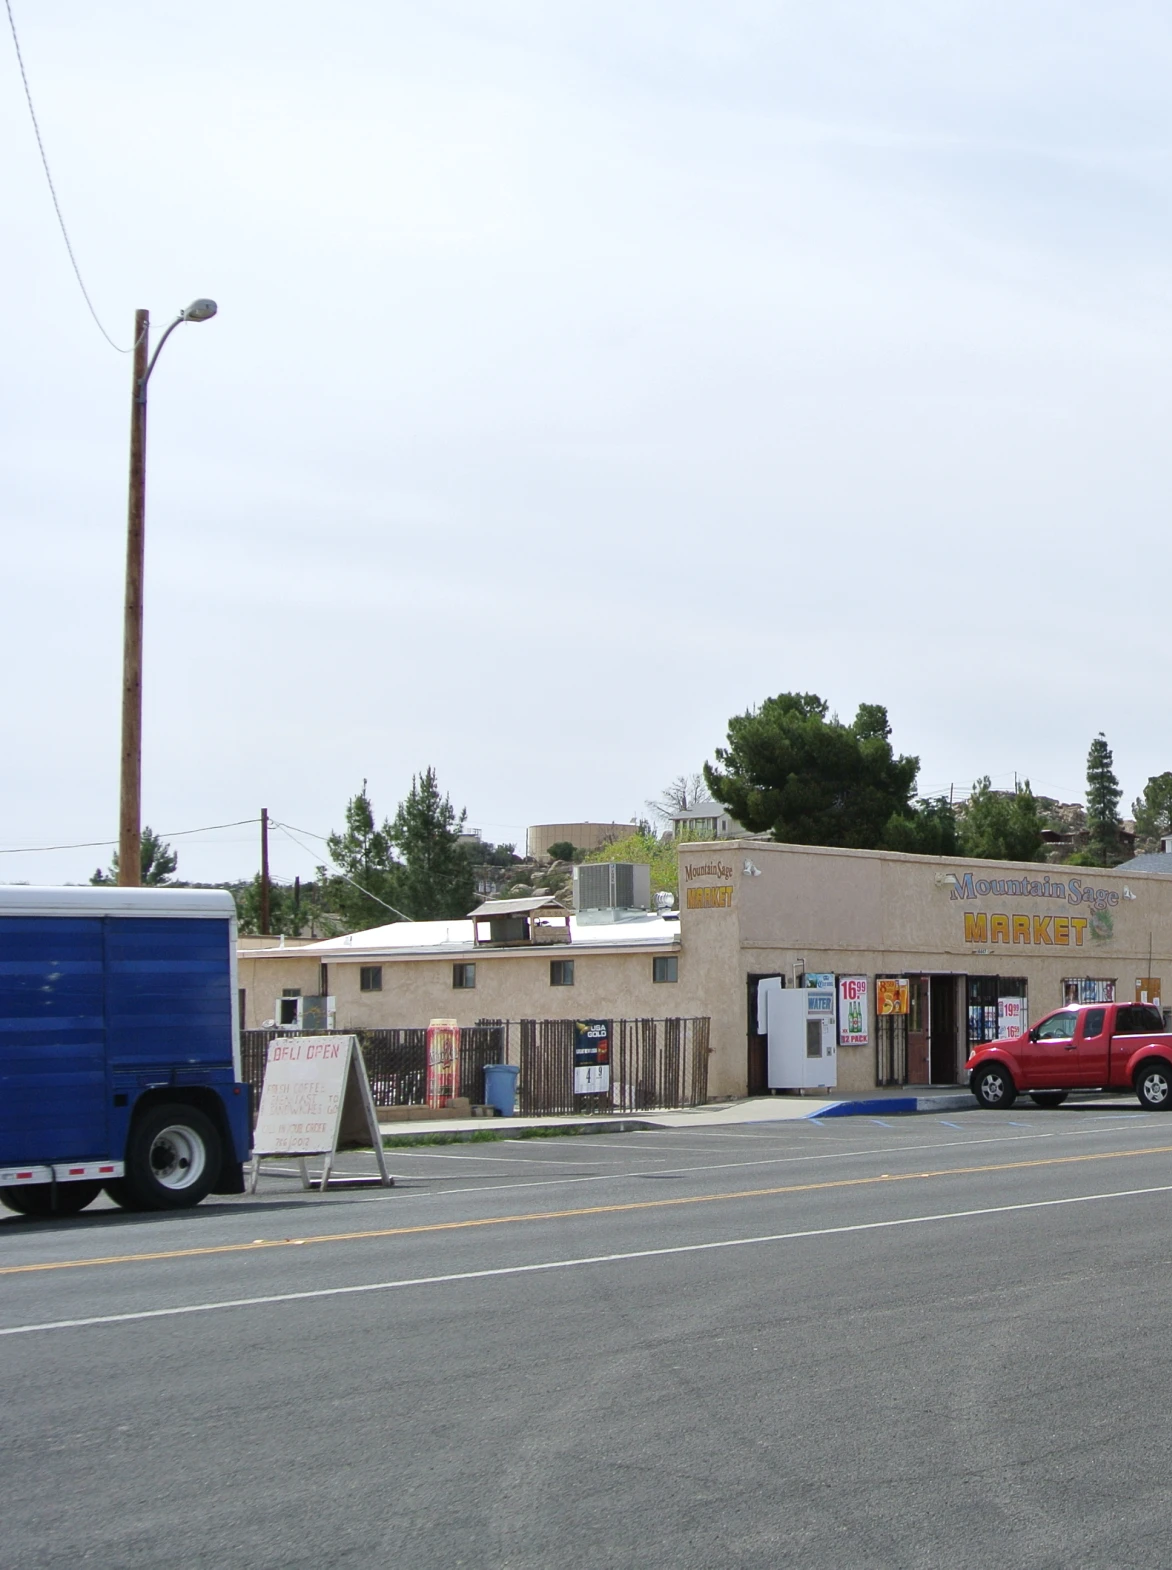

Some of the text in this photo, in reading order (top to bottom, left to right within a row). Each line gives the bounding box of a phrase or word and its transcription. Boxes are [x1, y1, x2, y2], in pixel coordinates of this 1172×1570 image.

[685, 861, 733, 882] Mountain Sage
[687, 886, 733, 909] MARKET
[947, 872, 1120, 910] Mountain Sage
[964, 912, 1088, 946] MARKET
[808, 997, 831, 1010] WATER
[851, 1035, 868, 1043] PACK
[273, 1044, 340, 1061] DELI OPEN
